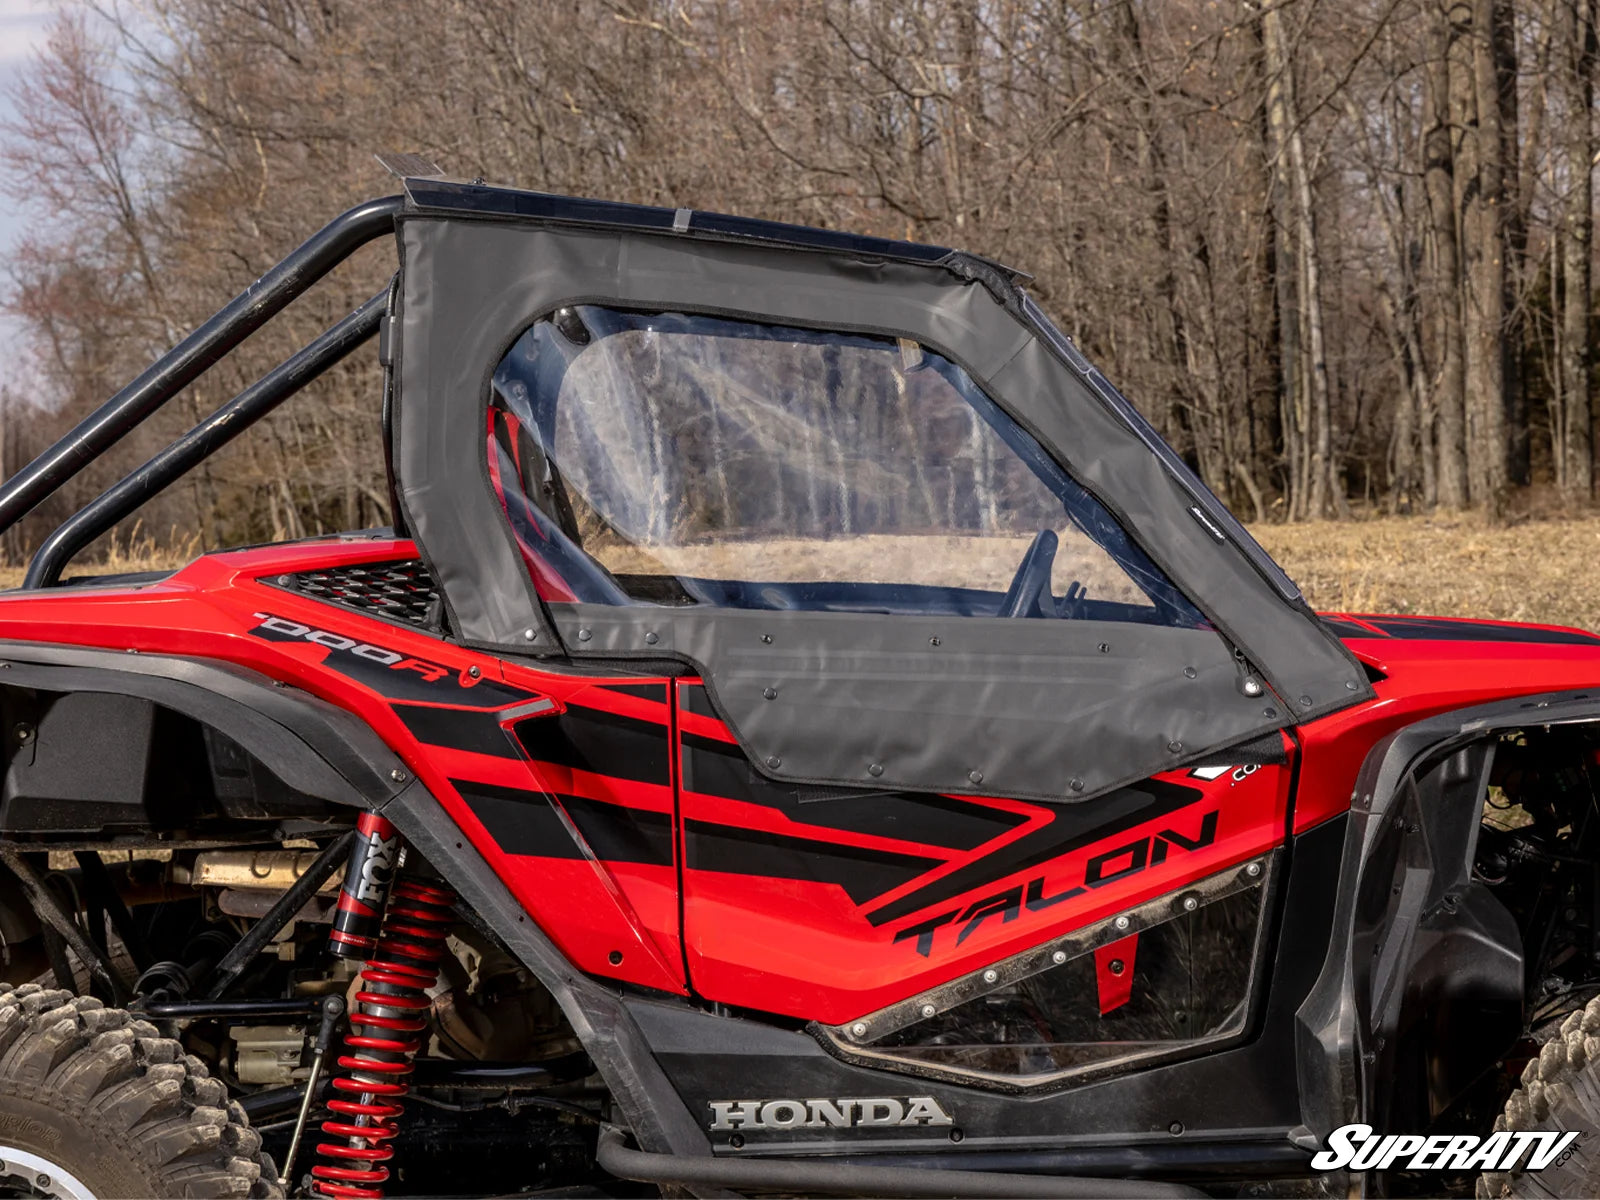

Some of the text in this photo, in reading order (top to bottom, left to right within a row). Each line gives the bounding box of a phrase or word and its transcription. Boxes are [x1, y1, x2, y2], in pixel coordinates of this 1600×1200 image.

[1230, 763, 1262, 787] .CO
[356, 831, 398, 904] FOX
[893, 809, 1219, 958] TALON
[708, 1096, 953, 1130] HONDA
